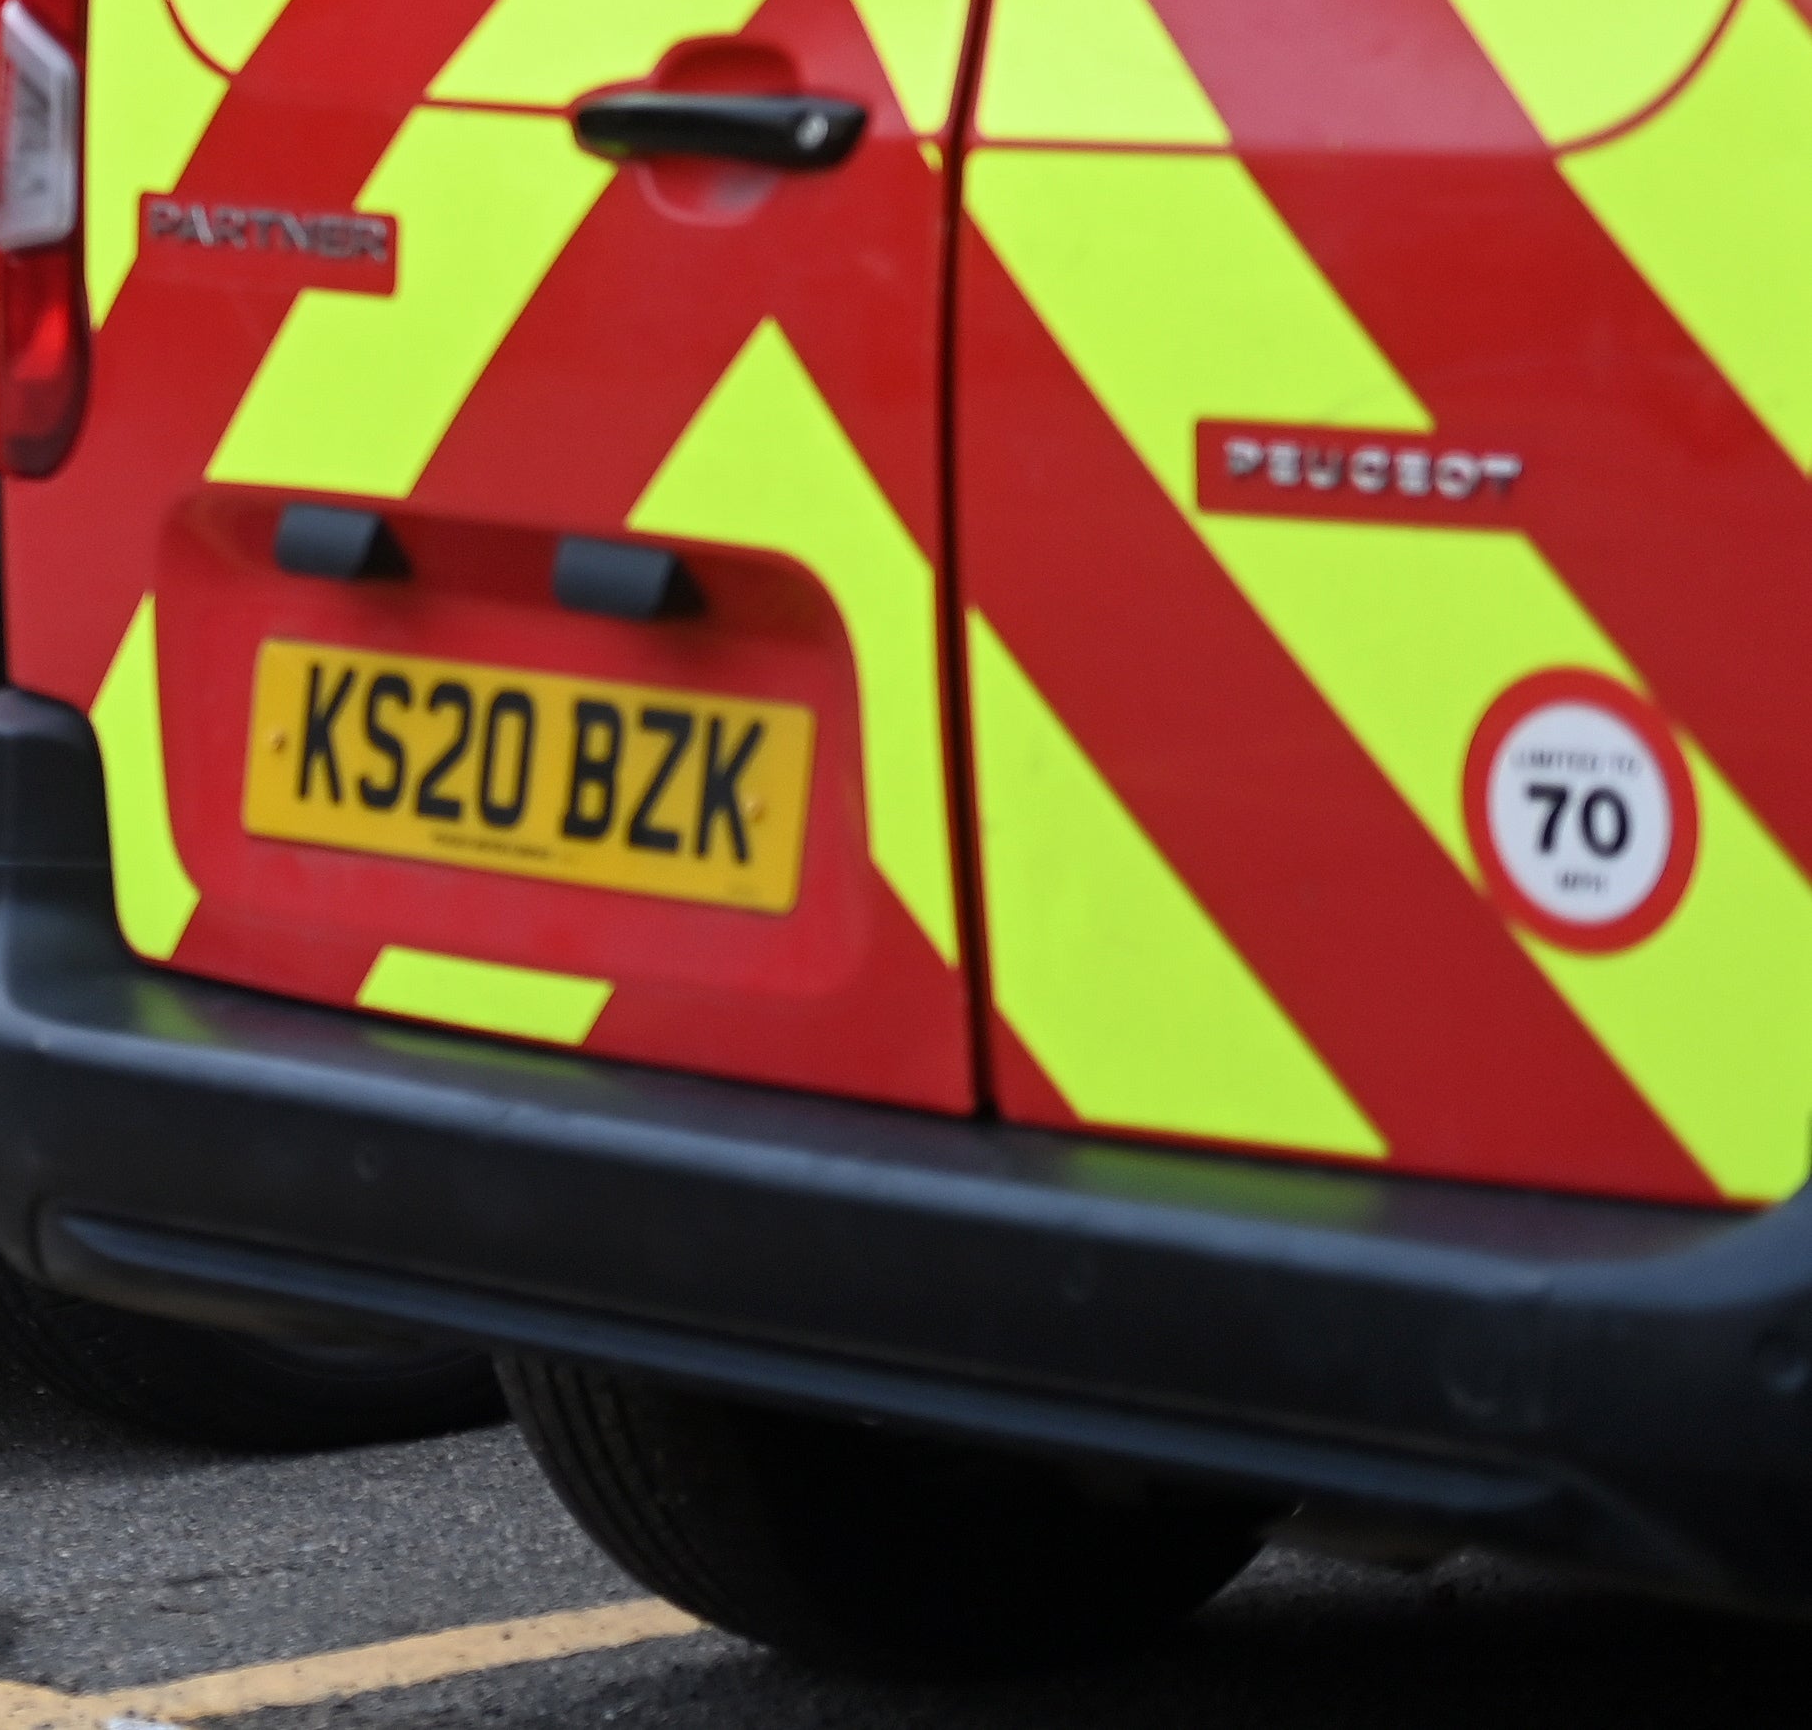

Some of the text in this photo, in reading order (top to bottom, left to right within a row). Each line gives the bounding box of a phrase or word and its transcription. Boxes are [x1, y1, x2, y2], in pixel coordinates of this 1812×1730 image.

[149, 199, 388, 263] PARTNER
[293, 661, 768, 865] KS20 BZK
[1527, 783, 1633, 860] 70
